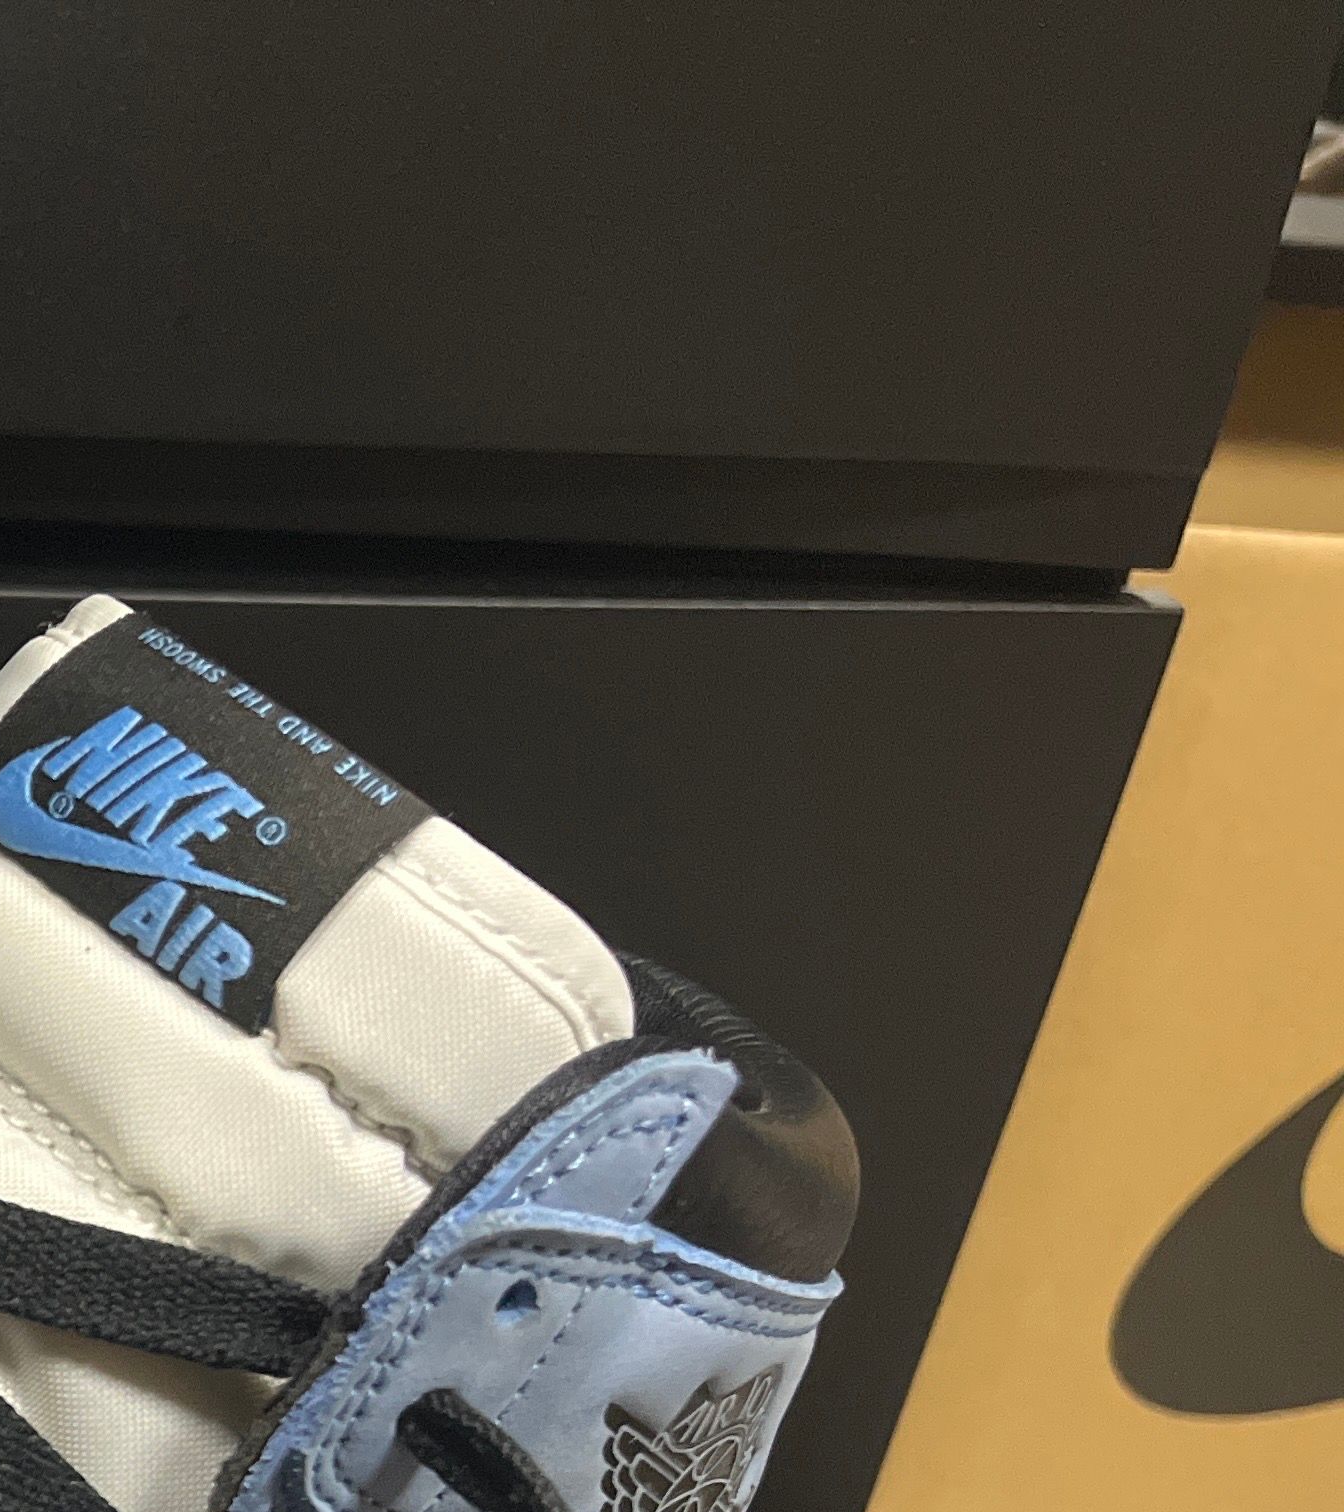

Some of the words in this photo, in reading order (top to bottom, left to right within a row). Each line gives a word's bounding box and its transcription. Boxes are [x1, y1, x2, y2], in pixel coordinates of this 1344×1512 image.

[137, 626, 226, 685] SWOOSH
[227, 680, 274, 719] THE
[278, 714, 341, 758] AND
[42, 705, 266, 864] NIKE
[333, 754, 398, 807] NIKE
[109, 879, 254, 1008] AIR
[672, 1393, 737, 1444] AIR
